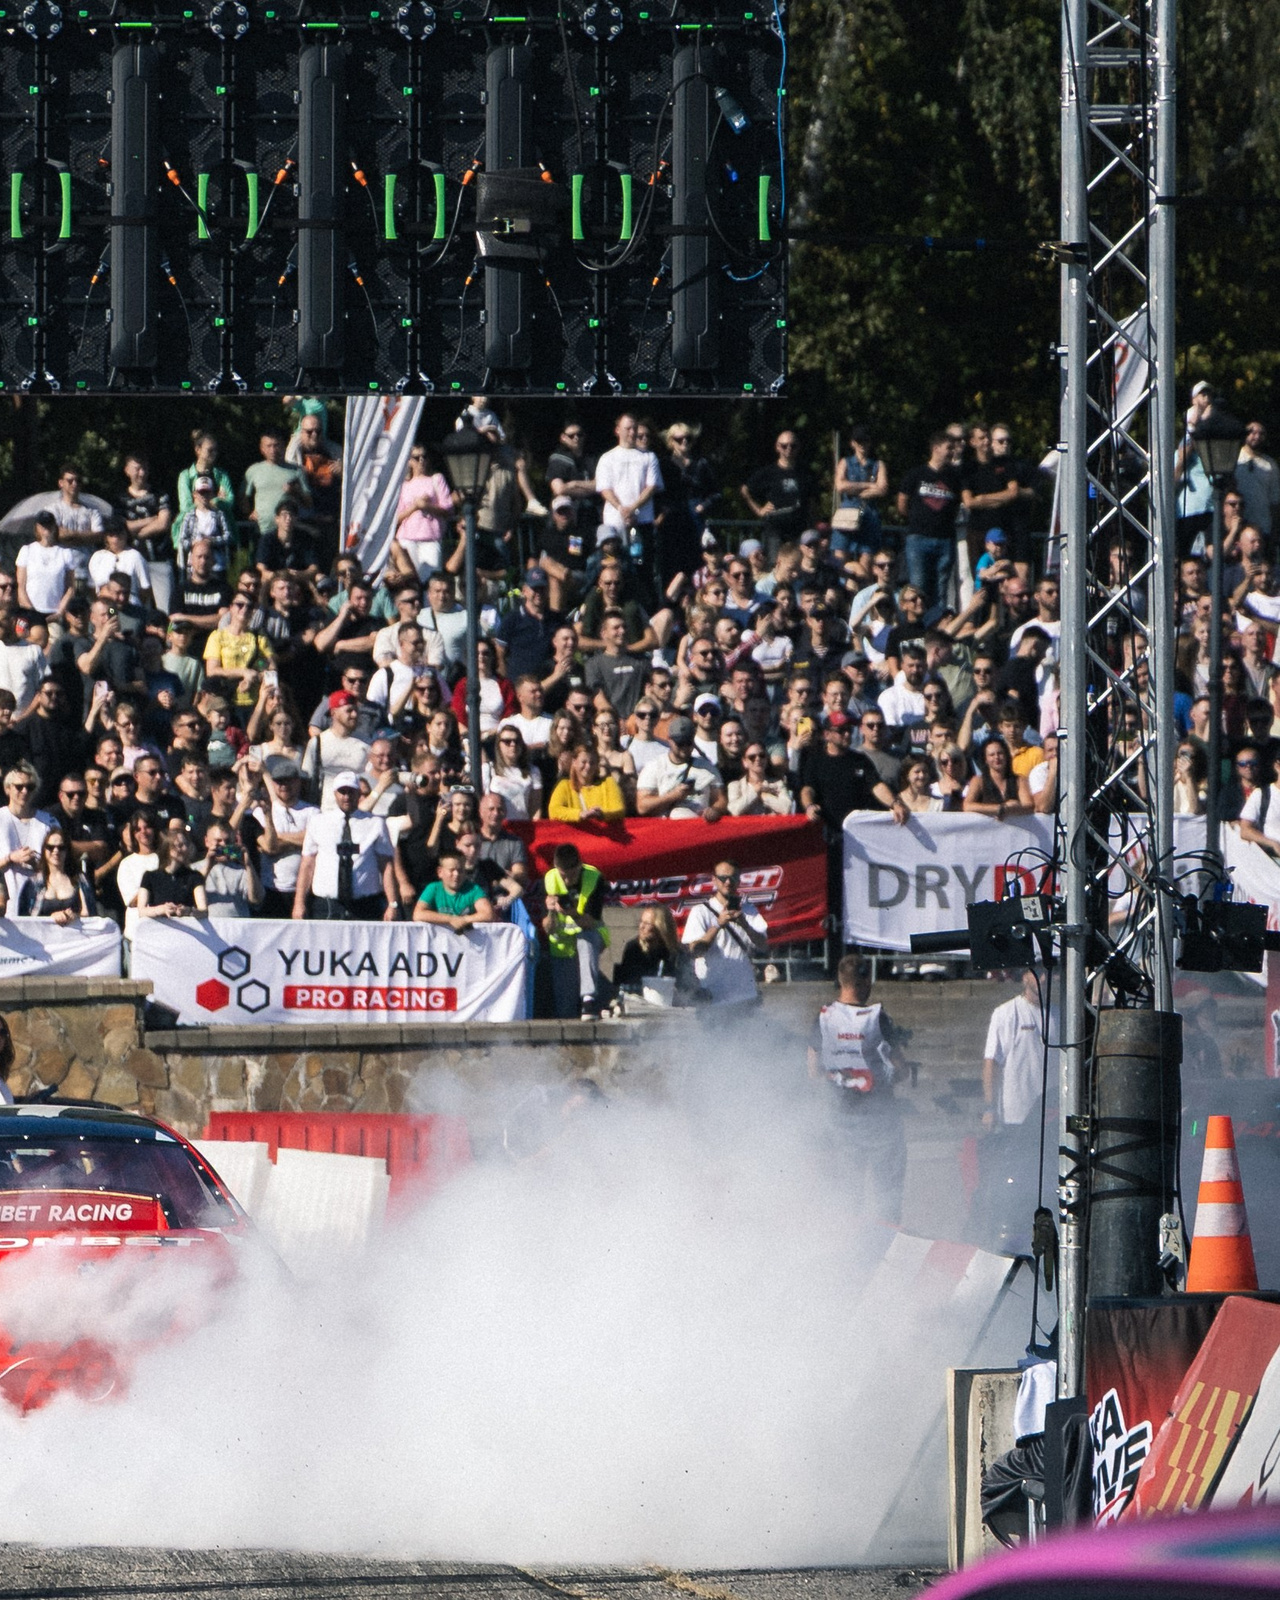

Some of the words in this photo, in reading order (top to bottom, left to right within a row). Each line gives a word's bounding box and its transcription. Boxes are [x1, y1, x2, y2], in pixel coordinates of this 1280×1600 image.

[277, 950, 379, 977] YUKA
[388, 951, 464, 978] ADV
[295, 988, 345, 1008] PRO
[352, 988, 446, 1009] RACING
[48, 1202, 134, 1223] RACING
